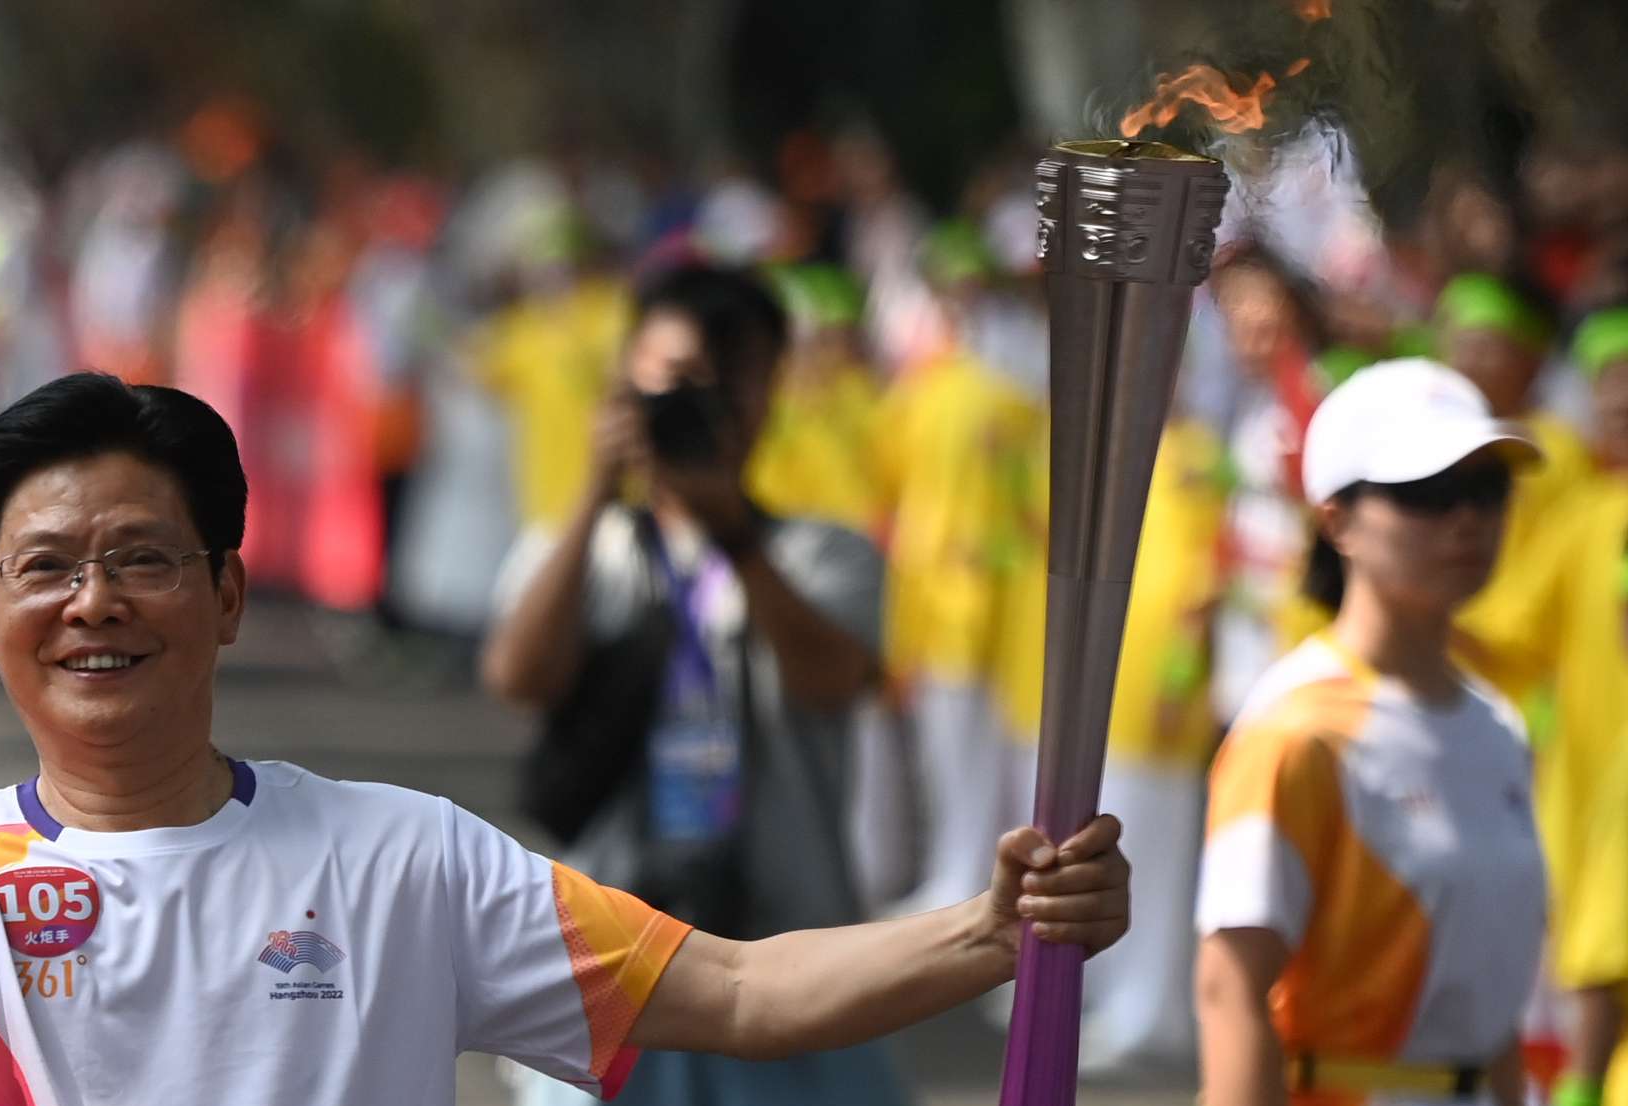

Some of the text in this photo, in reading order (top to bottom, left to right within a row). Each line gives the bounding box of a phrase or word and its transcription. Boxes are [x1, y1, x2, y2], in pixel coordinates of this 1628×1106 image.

[24, 929, 70, 945] 火炬手
[269, 990, 344, 1001] Hangzhou 2022
